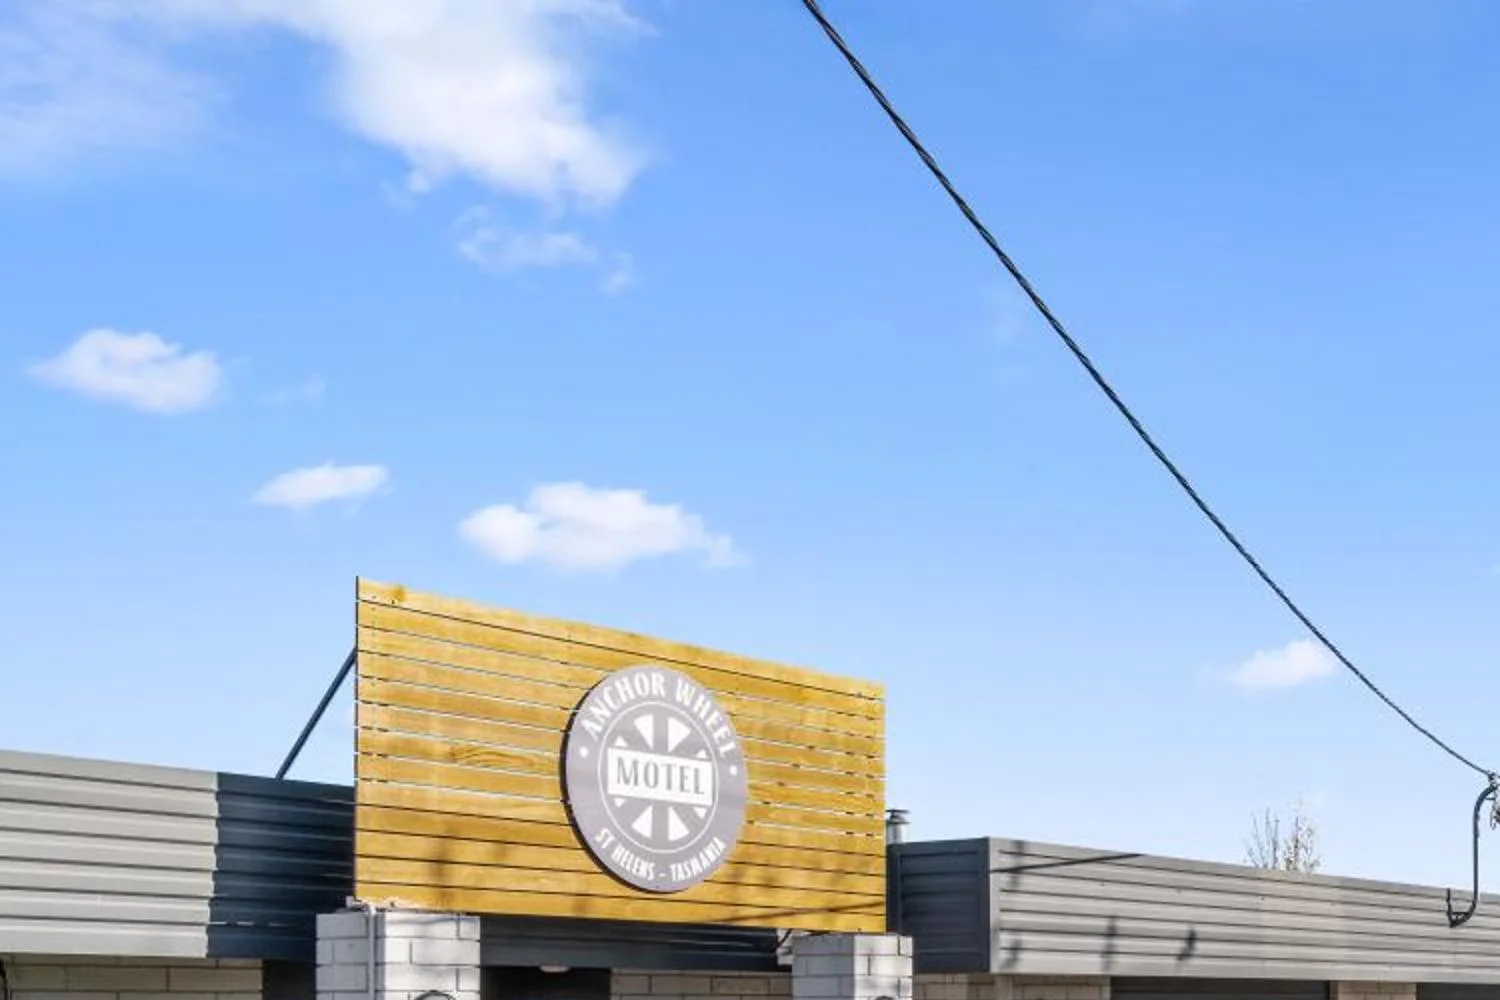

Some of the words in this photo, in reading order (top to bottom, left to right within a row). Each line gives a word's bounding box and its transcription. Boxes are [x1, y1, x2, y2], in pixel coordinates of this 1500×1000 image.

[582, 671, 665, 740] ANCHOR
[675, 679, 737, 758] WHEEL
[617, 757, 705, 794] MOTEL
[595, 828, 613, 849] ST
[611, 843, 655, 881] HELENS
[669, 836, 727, 881] TASMANIA
